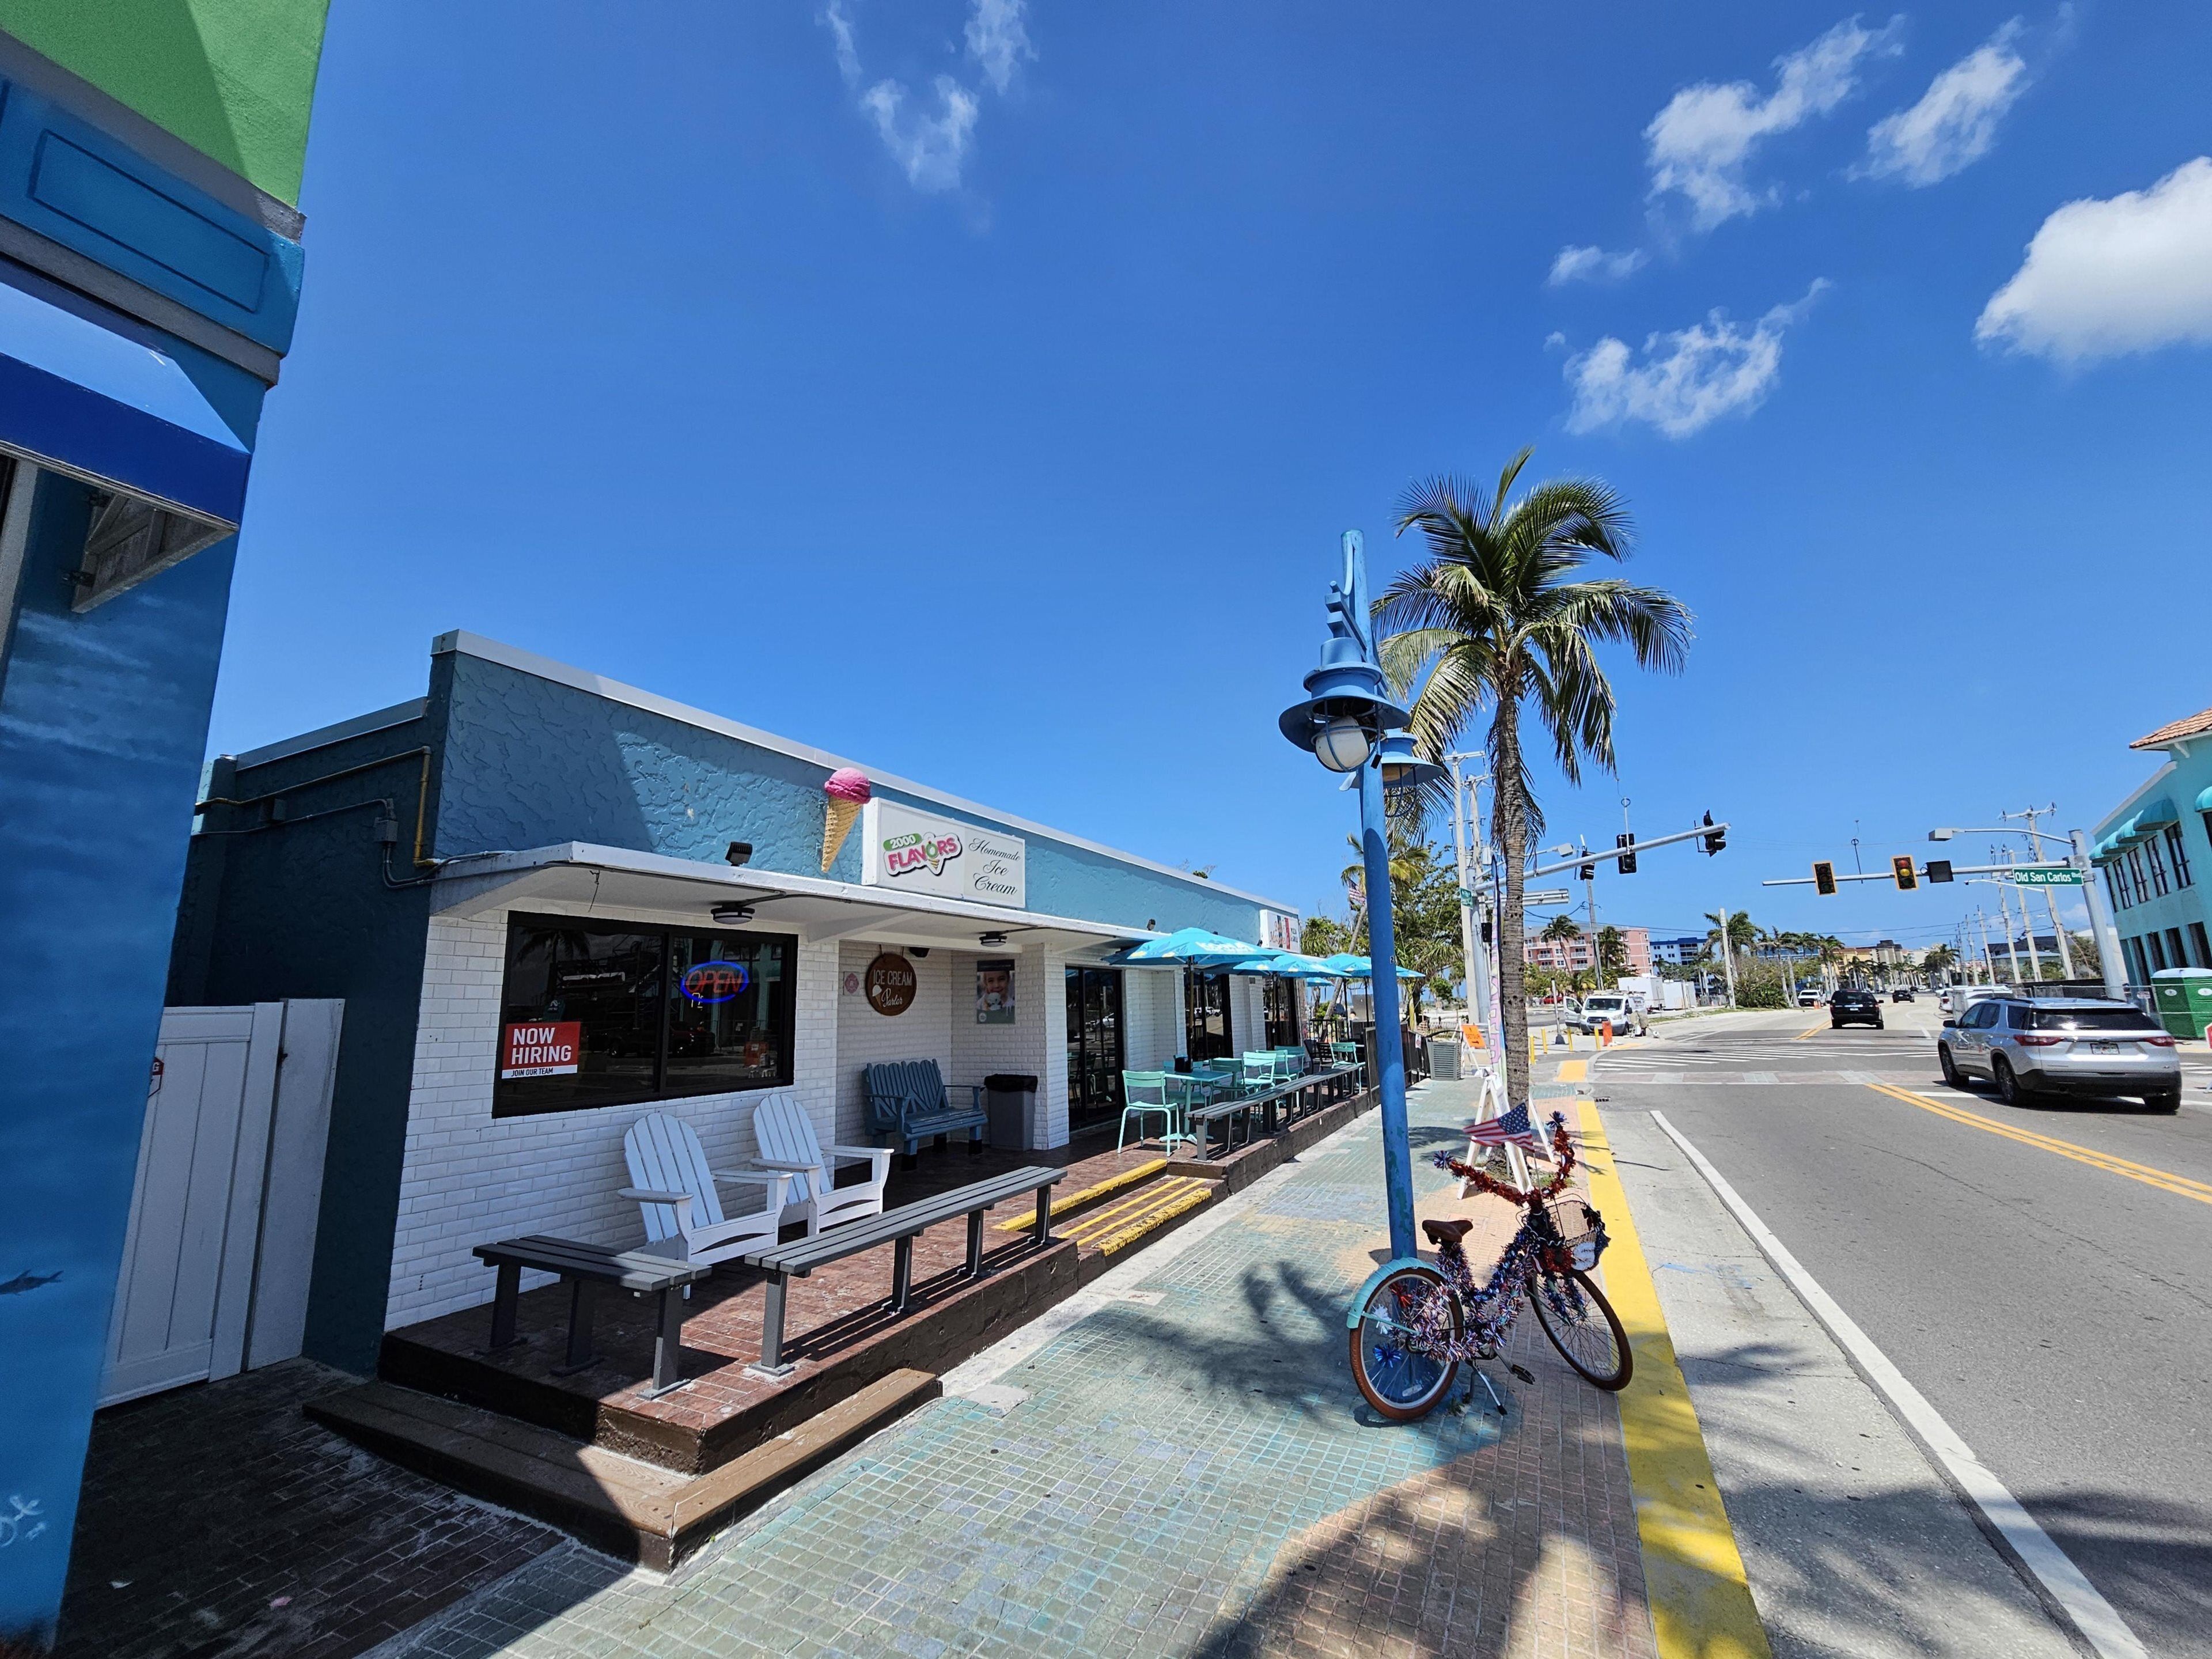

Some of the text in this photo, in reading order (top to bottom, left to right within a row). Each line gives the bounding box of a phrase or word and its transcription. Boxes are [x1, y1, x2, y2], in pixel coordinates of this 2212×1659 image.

[890, 835, 916, 849] 2000
[969, 838, 1021, 861] Homemade
[888, 838, 957, 871] FLAVORS
[983, 859, 1009, 876] Ice
[2015, 872, 2029, 882] Old
[2030, 872, 2046, 882] San
[2047, 872, 2072, 882] Carlos
[973, 873, 1017, 895] Cream
[685, 970, 743, 993] OPEN
[873, 969, 912, 986] ICE CREAM
[881, 988, 903, 1007] Parlor
[513, 1027, 556, 1046] NOW
[511, 1045, 572, 1065] HIRING
[511, 1069, 525, 1077] JOIN
